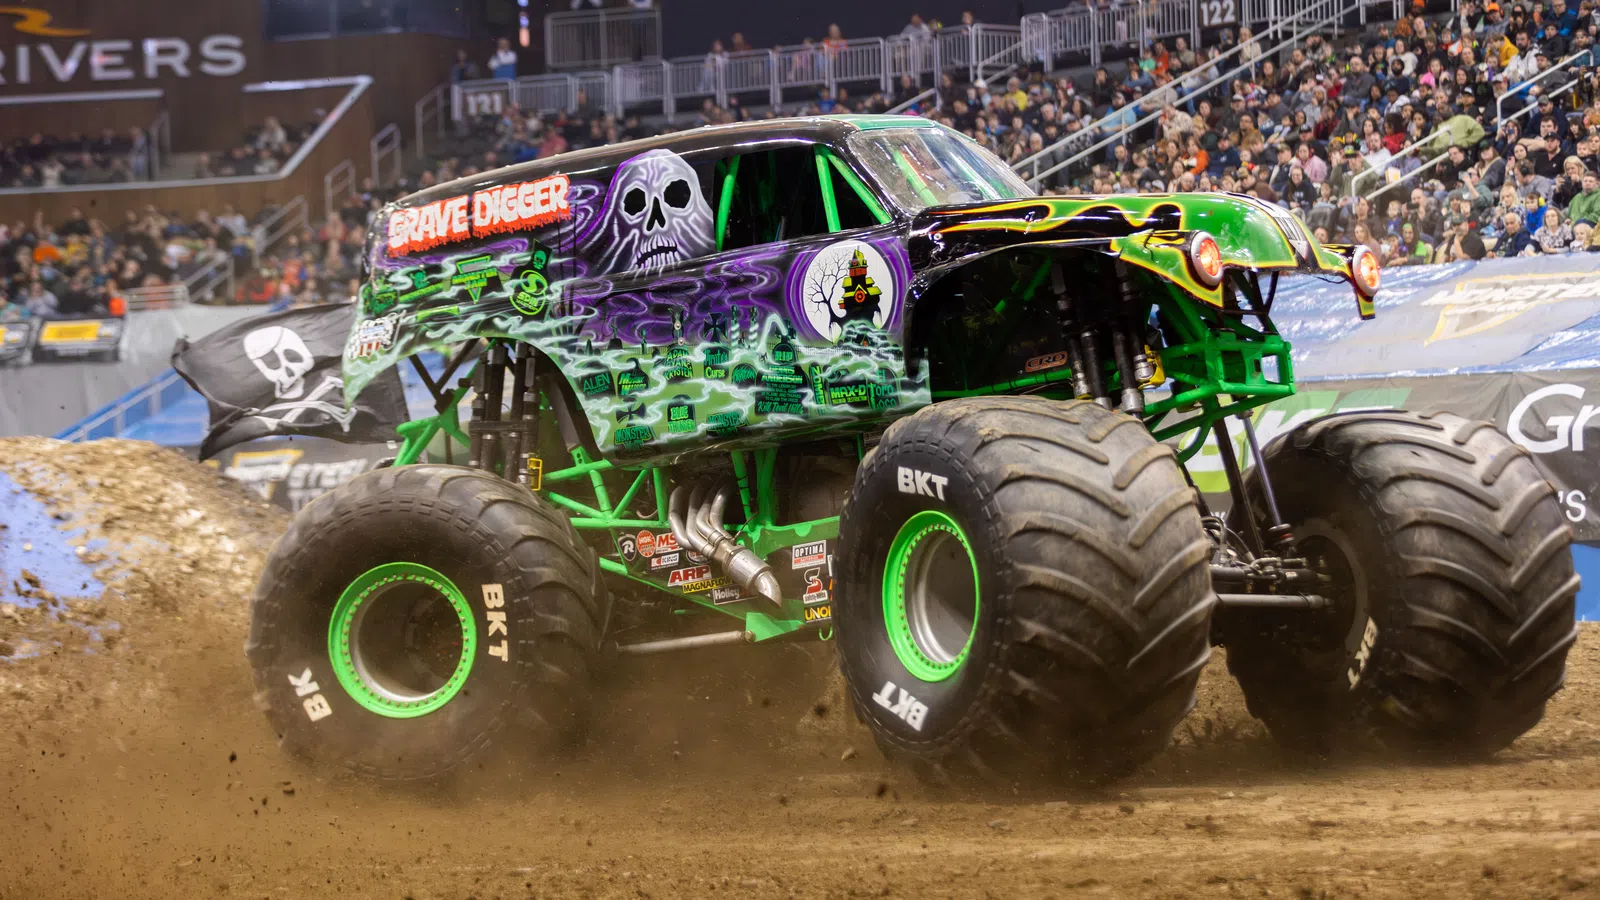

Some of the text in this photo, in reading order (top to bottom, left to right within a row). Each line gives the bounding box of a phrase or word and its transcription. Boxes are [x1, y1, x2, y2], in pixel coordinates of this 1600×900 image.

[1200, 0, 1235, 27] 122
[0, 35, 246, 84] IVERS
[466, 92, 502, 116] 121
[389, 177, 569, 249] GRAVE DIGGER
[667, 350, 689, 361] ADAM
[775, 351, 793, 361] RIP
[1028, 353, 1065, 367] CRD
[706, 367, 725, 379] Curse
[761, 374, 803, 384] ANDERSON
[583, 373, 611, 391] ALIEN
[830, 384, 866, 399] MAX-D
[670, 405, 689, 420] BLUE
[615, 426, 651, 443] MONSTER
[897, 466, 949, 502] BKT
[657, 532, 678, 546] MS
[795, 543, 824, 558] OPTIMA
[669, 565, 710, 584] ARP
[684, 576, 731, 592] MAGNAFLOW
[714, 588, 740, 600] Holley
[481, 583, 508, 662] BKT
[1347, 616, 1378, 691] BKT
[287, 667, 333, 722] BK
[872, 681, 929, 732] BKT
